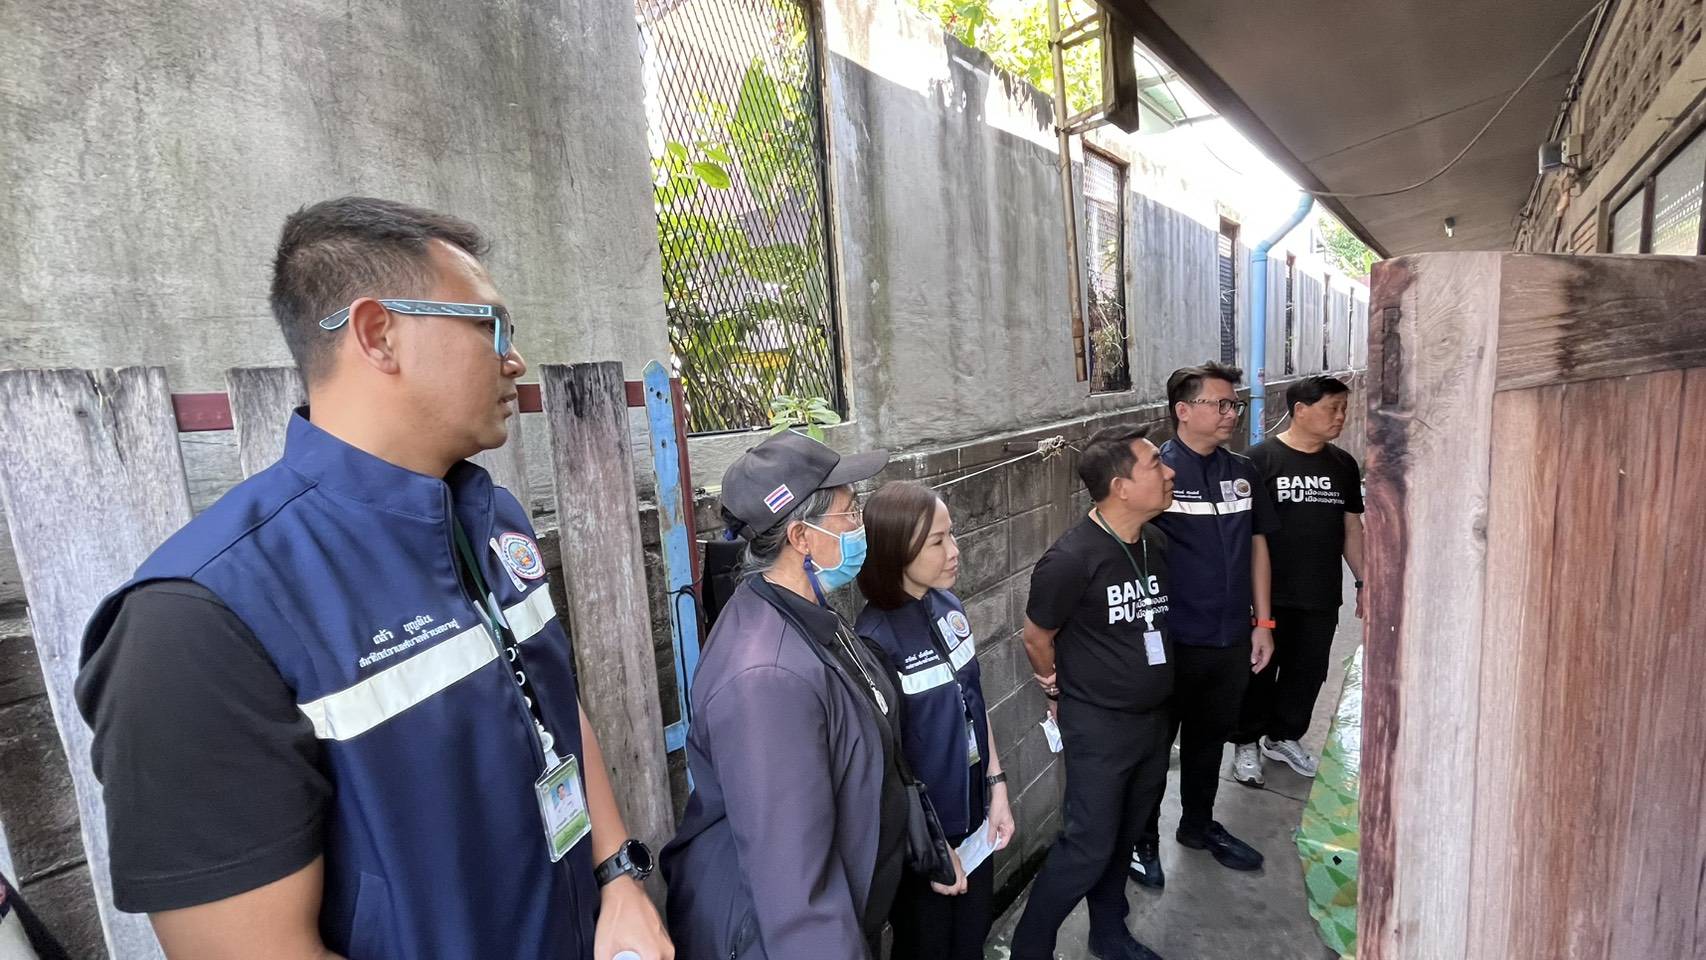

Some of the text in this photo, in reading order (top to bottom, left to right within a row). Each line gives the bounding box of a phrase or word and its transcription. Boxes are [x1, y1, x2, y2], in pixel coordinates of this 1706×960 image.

[1277, 475, 1331, 490] BANG
[1277, 489, 1304, 503] PU
[1106, 575, 1160, 607] BANG
[1109, 601, 1136, 625] PU
